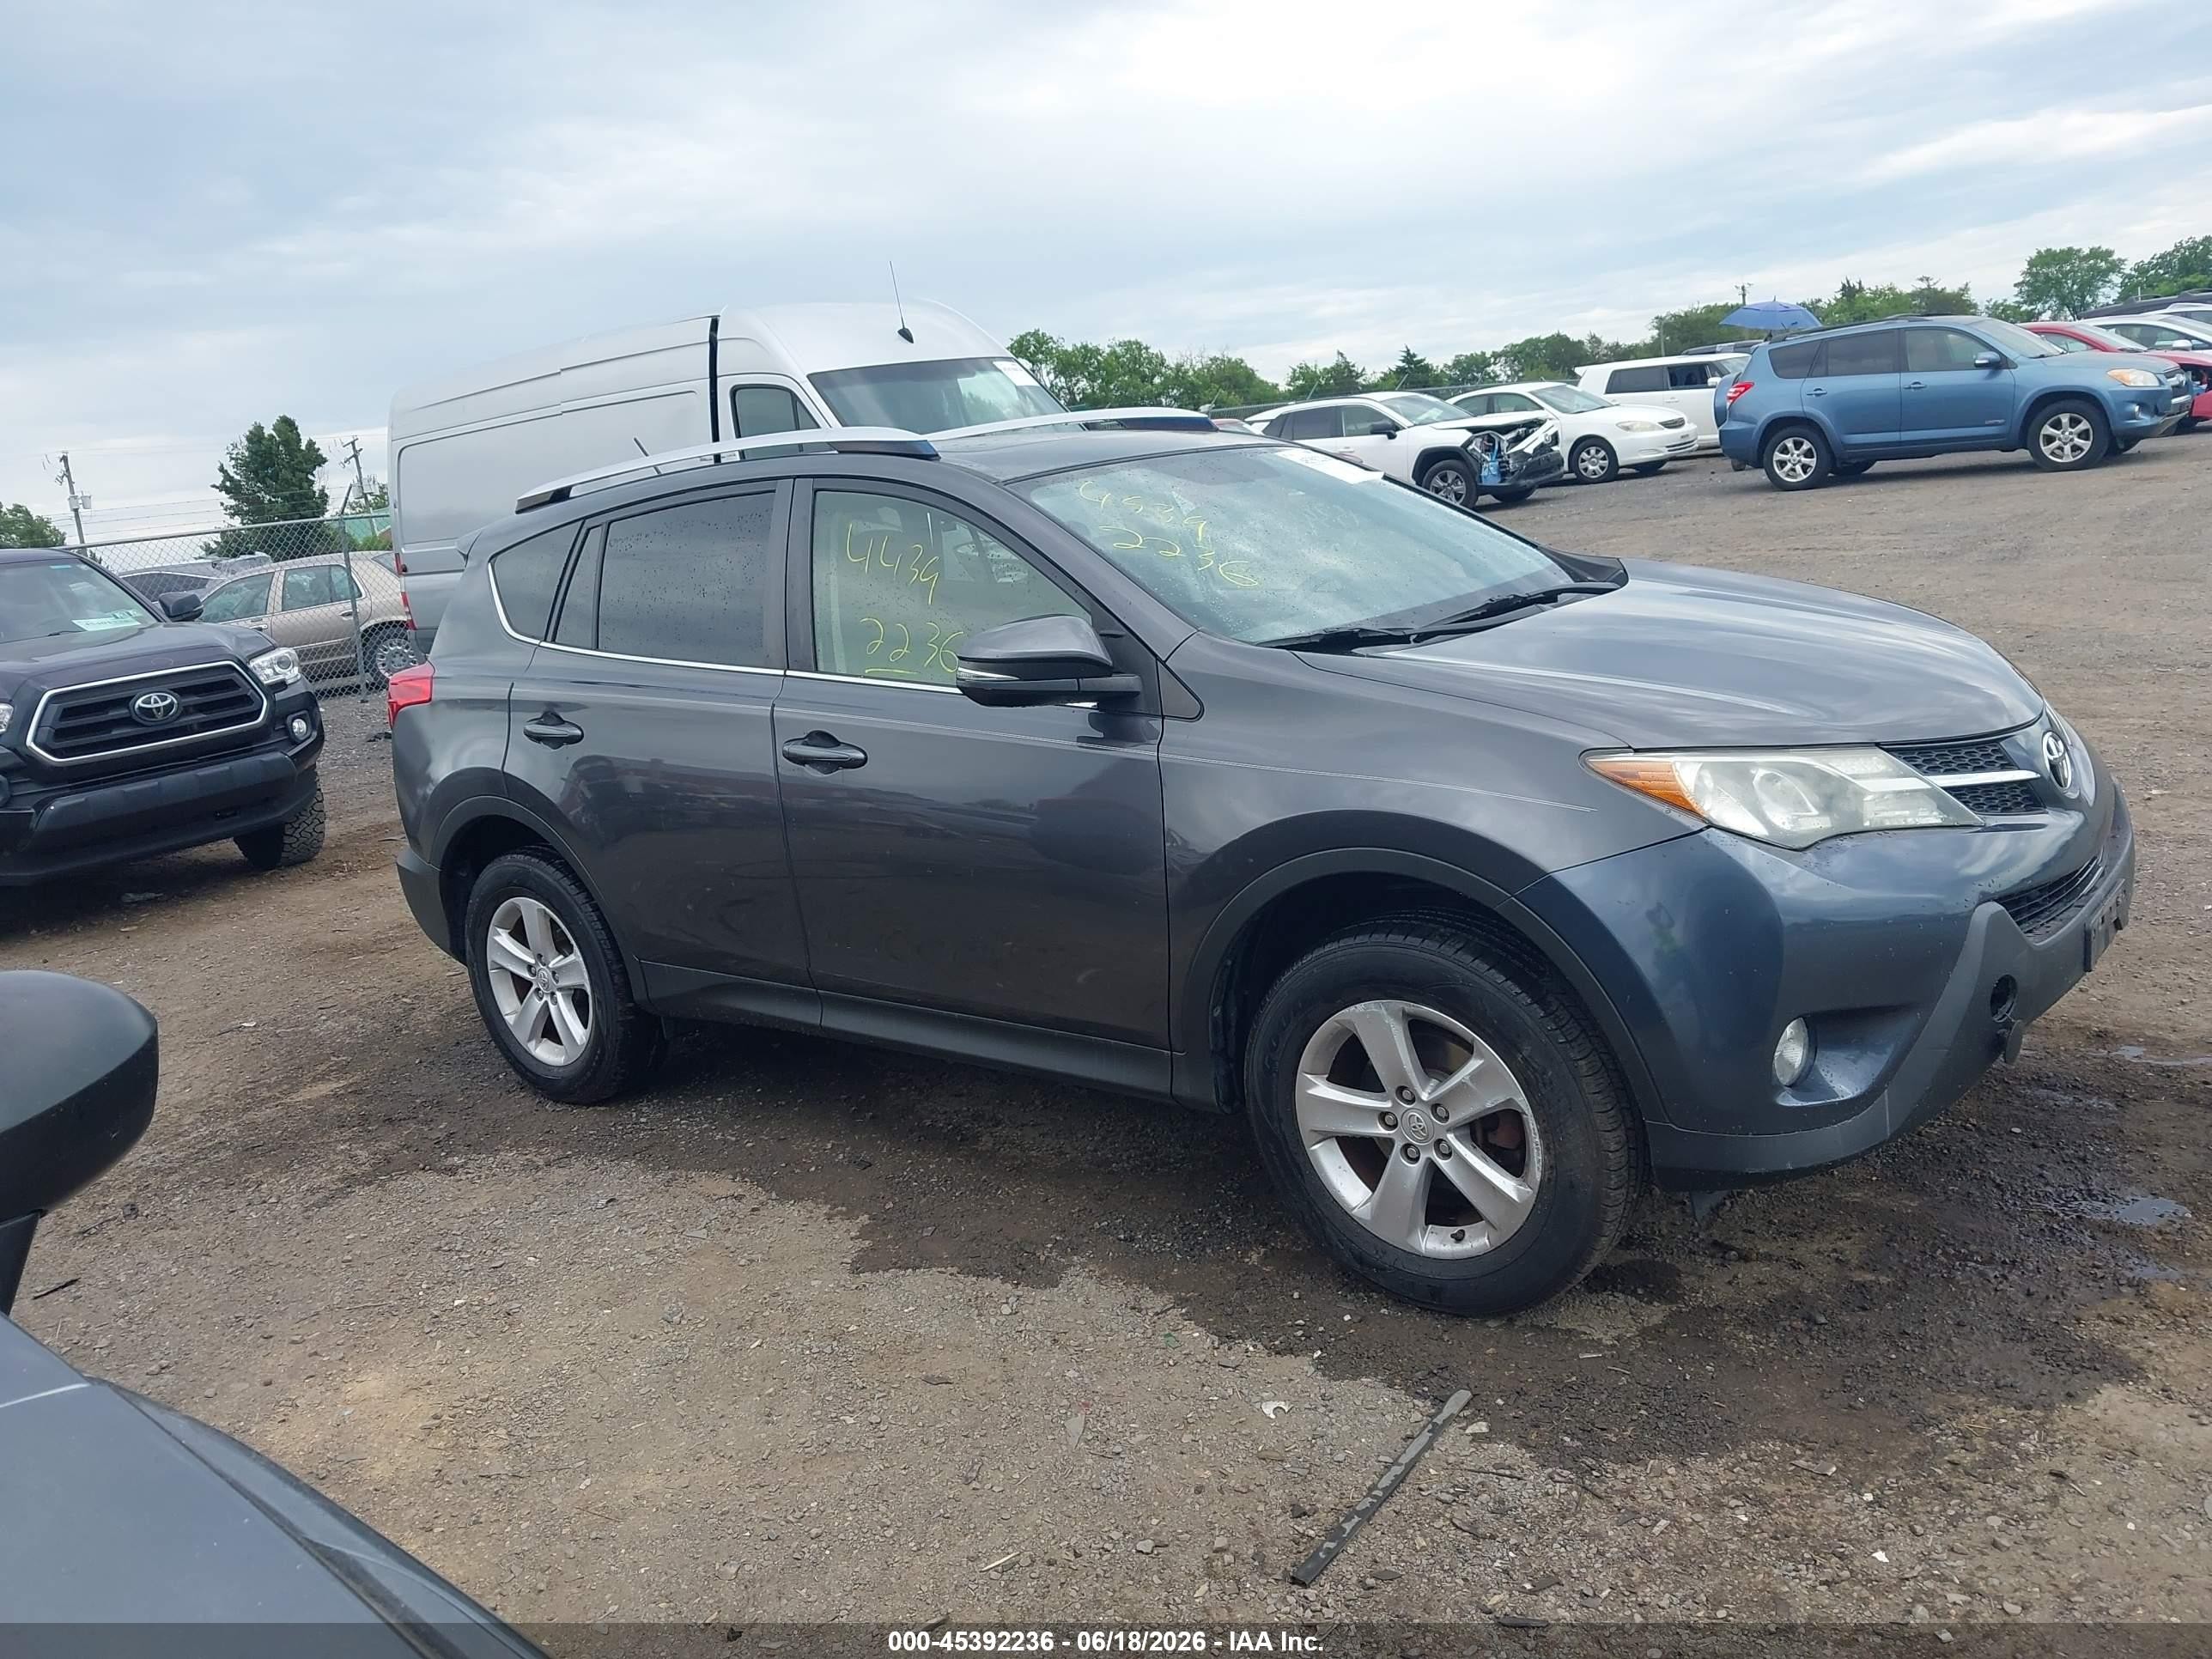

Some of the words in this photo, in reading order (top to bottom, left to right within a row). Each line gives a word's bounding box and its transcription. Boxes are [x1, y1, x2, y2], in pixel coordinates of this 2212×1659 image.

[846, 523, 942, 605] 4439
[1098, 526, 1258, 586] 2236
[860, 617, 964, 673] 2236
